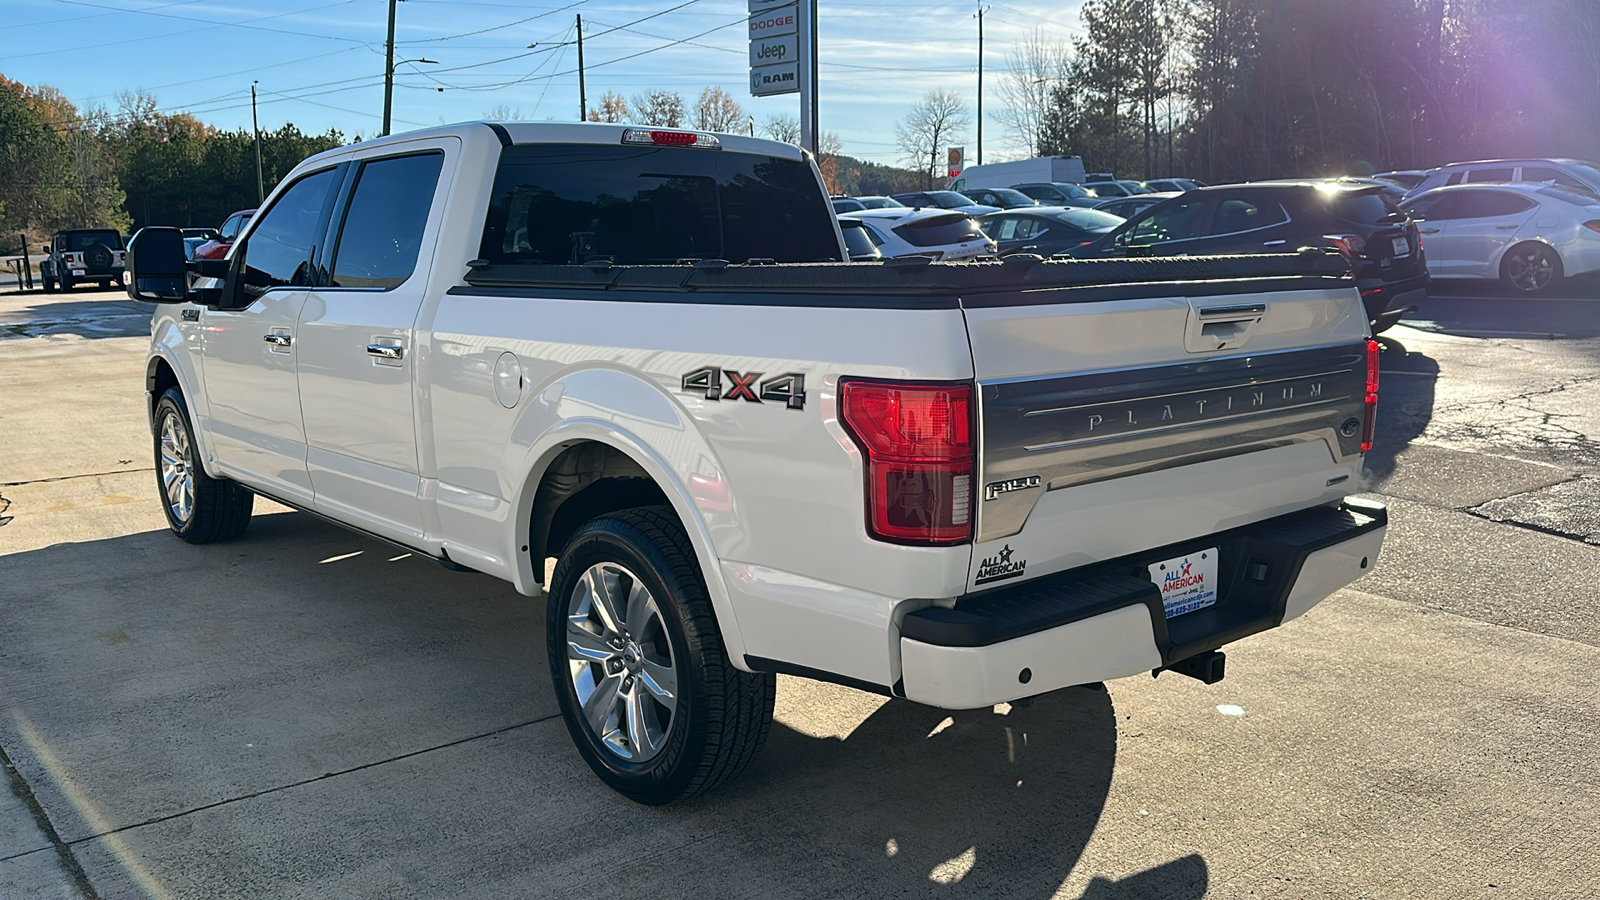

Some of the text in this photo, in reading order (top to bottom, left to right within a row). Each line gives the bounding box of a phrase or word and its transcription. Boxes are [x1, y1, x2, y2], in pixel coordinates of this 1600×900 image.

[750, 15, 794, 31] DODGE
[757, 43, 786, 60] Jeep
[762, 72, 794, 84] RAM
[1088, 382, 1323, 431] PLATINUM
[976, 559, 1026, 579] AMERICAN
[980, 556, 999, 569] ALL
[1163, 573, 1203, 593] AMERICAN
[1165, 570, 1181, 582] ALL
